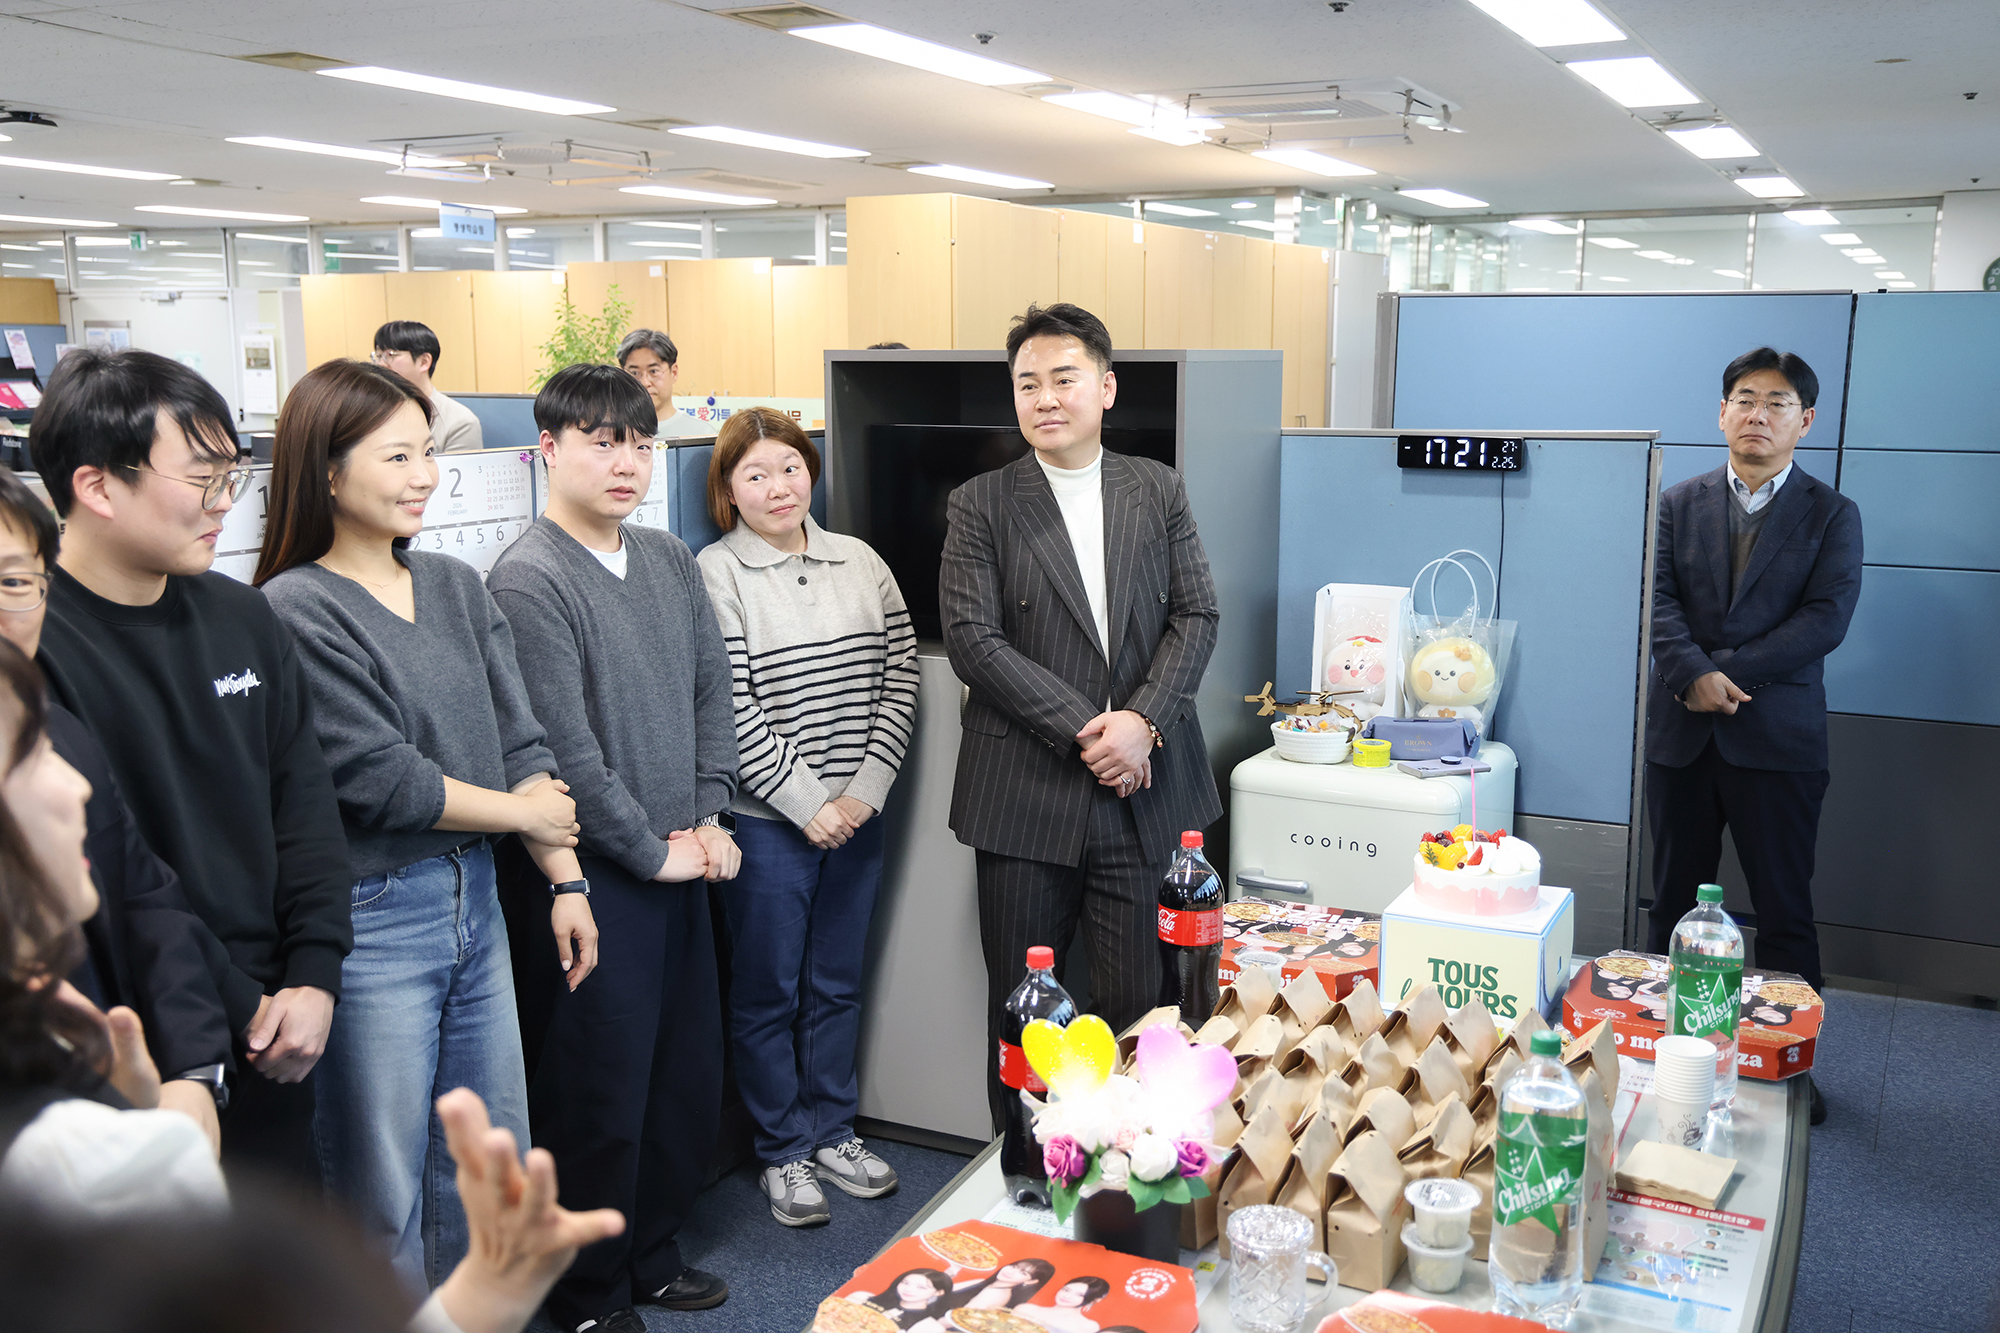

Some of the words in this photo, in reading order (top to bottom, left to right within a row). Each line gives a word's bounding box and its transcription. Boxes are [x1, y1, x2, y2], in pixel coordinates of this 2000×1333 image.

[448, 467, 464, 499] 2
[434, 533, 443, 549] 3
[456, 530, 464, 546] 4
[476, 528, 484, 544] 5
[496, 525, 504, 541] 6
[1404, 739, 1433, 747] BROWN
[1290, 833, 1377, 858] cooing
[1427, 957, 1499, 992] TOUS
[1683, 986, 1741, 1033] Chilsung
[1498, 1167, 1571, 1214] Chilsung
[1522, 1192, 1557, 1214] CIDER
